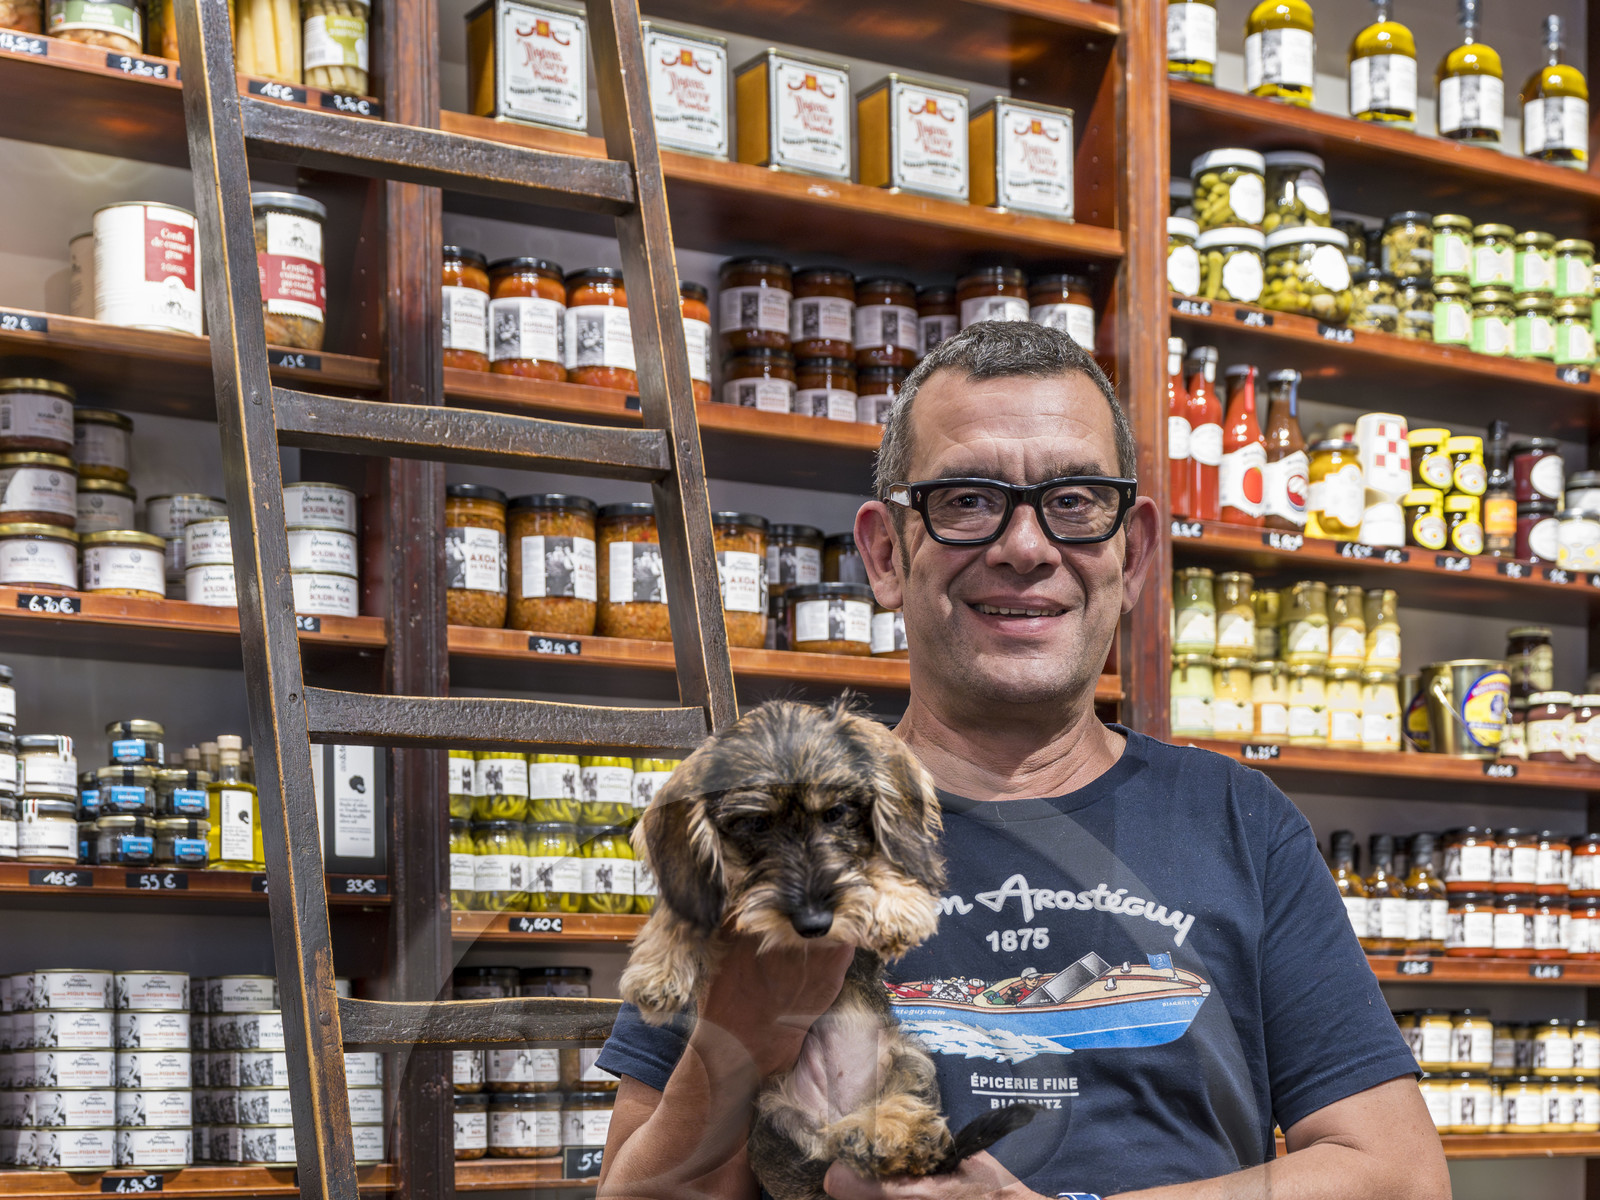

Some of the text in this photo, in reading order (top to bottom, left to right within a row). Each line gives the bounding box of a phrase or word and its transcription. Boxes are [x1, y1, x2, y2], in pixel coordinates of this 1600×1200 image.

[279, 354, 306, 369] 13€
[470, 554, 496, 563] AXOA
[139, 875, 161, 891] 55
[346, 879, 377, 894] 33€
[519, 917, 562, 932] 4,60€
[986, 927, 1050, 952] 1875
[970, 1072, 1079, 1091] ÉPICERIE FINE
